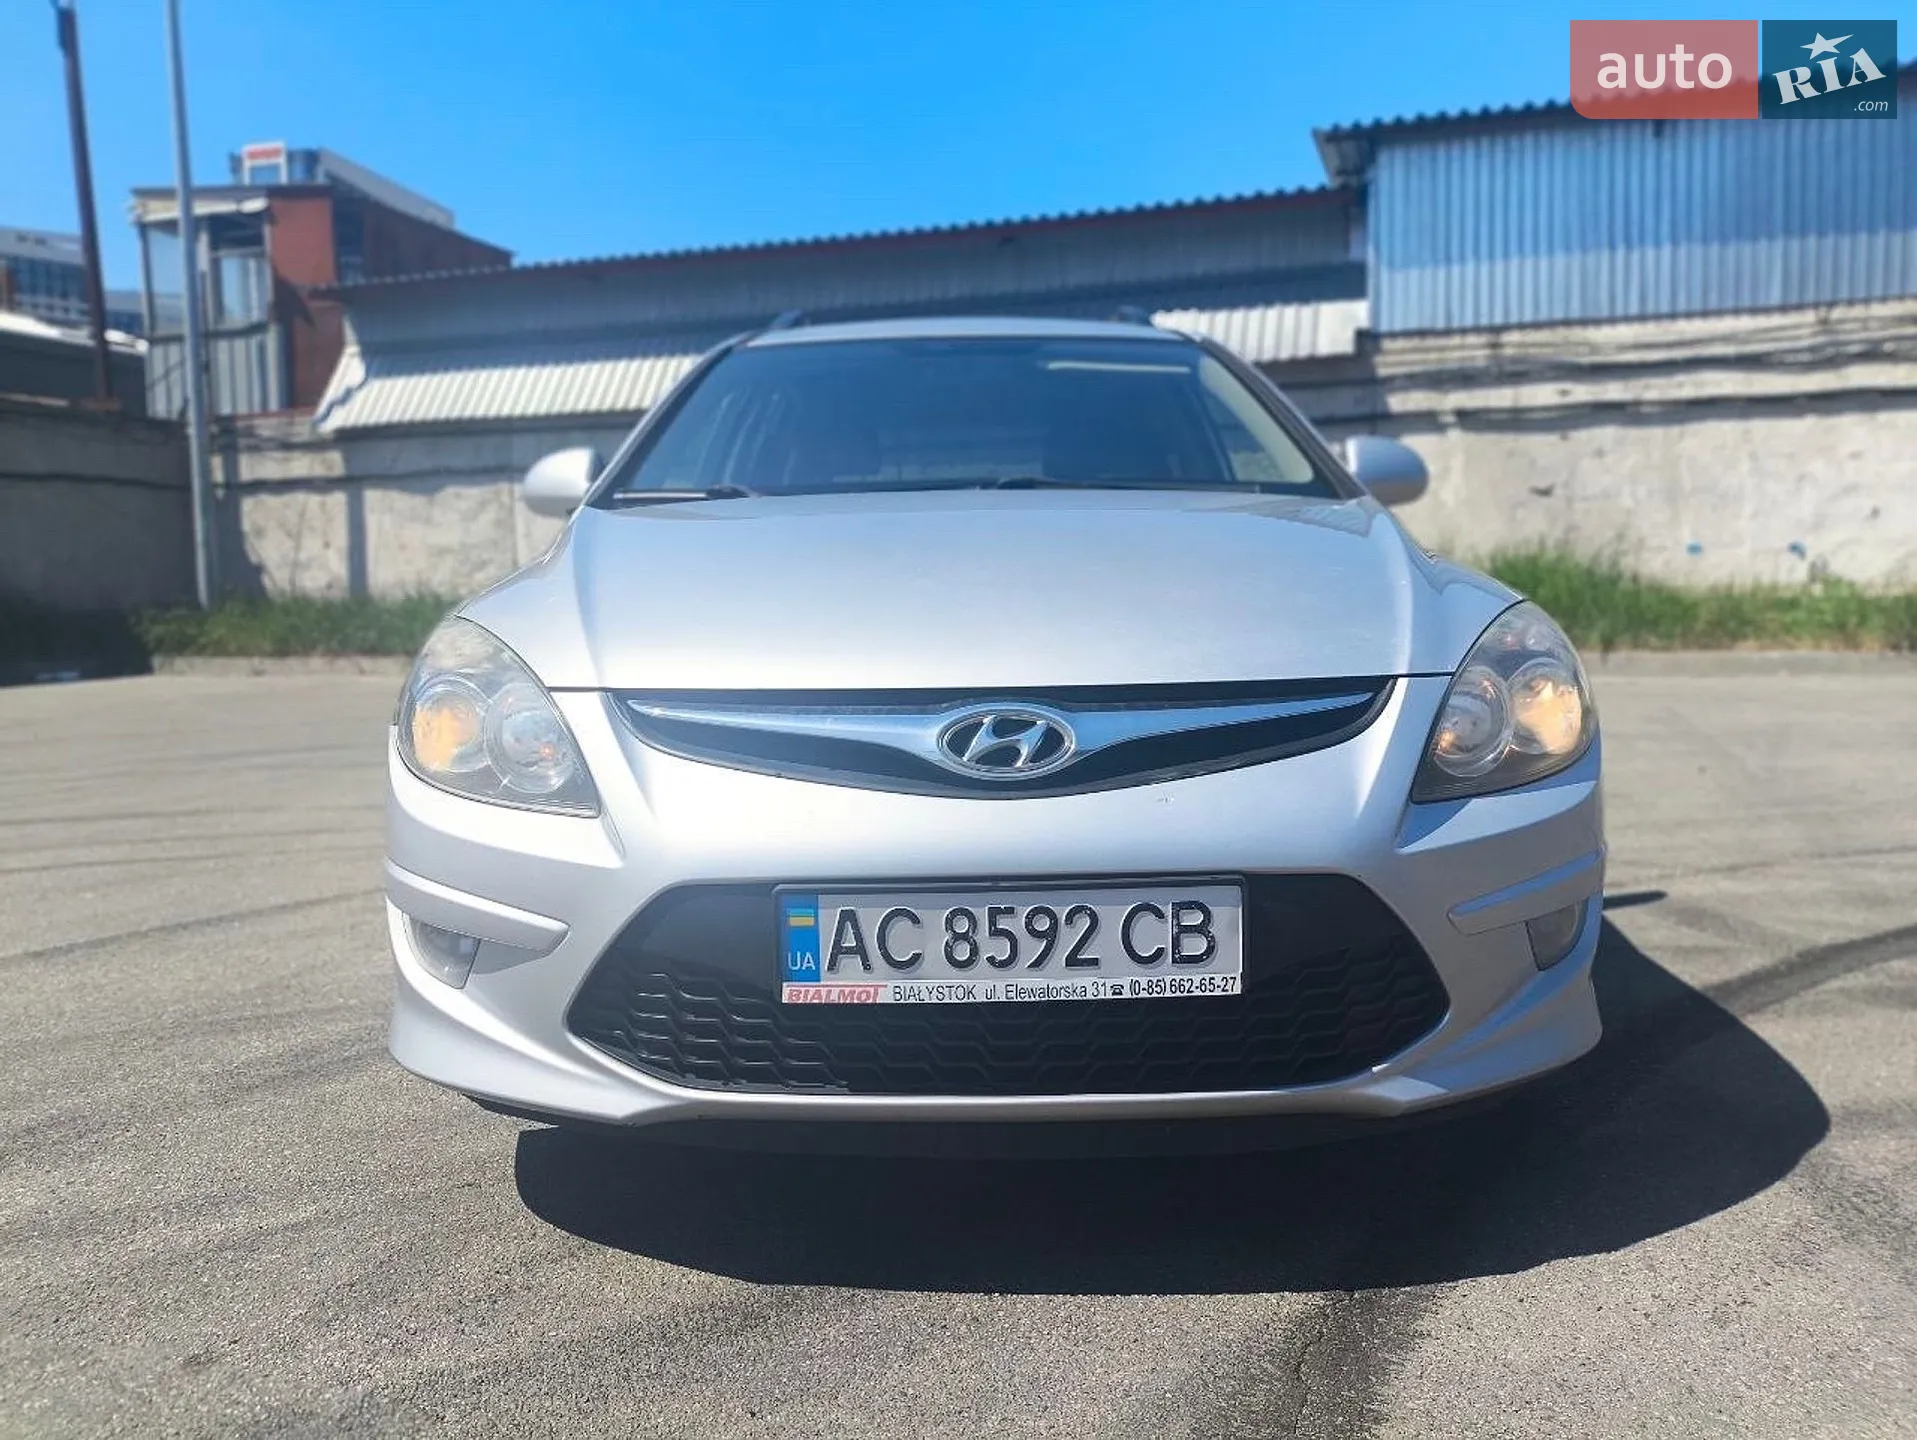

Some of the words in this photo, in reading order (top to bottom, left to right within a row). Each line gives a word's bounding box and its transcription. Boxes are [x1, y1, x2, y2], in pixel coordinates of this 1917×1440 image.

[825, 907, 923, 973] AC
[943, 904, 1100, 971] 8592
[1120, 900, 1217, 966] CB
[787, 951, 816, 971] UA
[892, 984, 977, 1002] BIAŁYSTOK
[985, 984, 999, 1001] ul.
[1004, 983, 1088, 1001] Elewatorska
[1091, 981, 1108, 998] 31
[1129, 978, 1167, 996] (0-85)
[1169, 976, 1237, 995] 662-65-27
